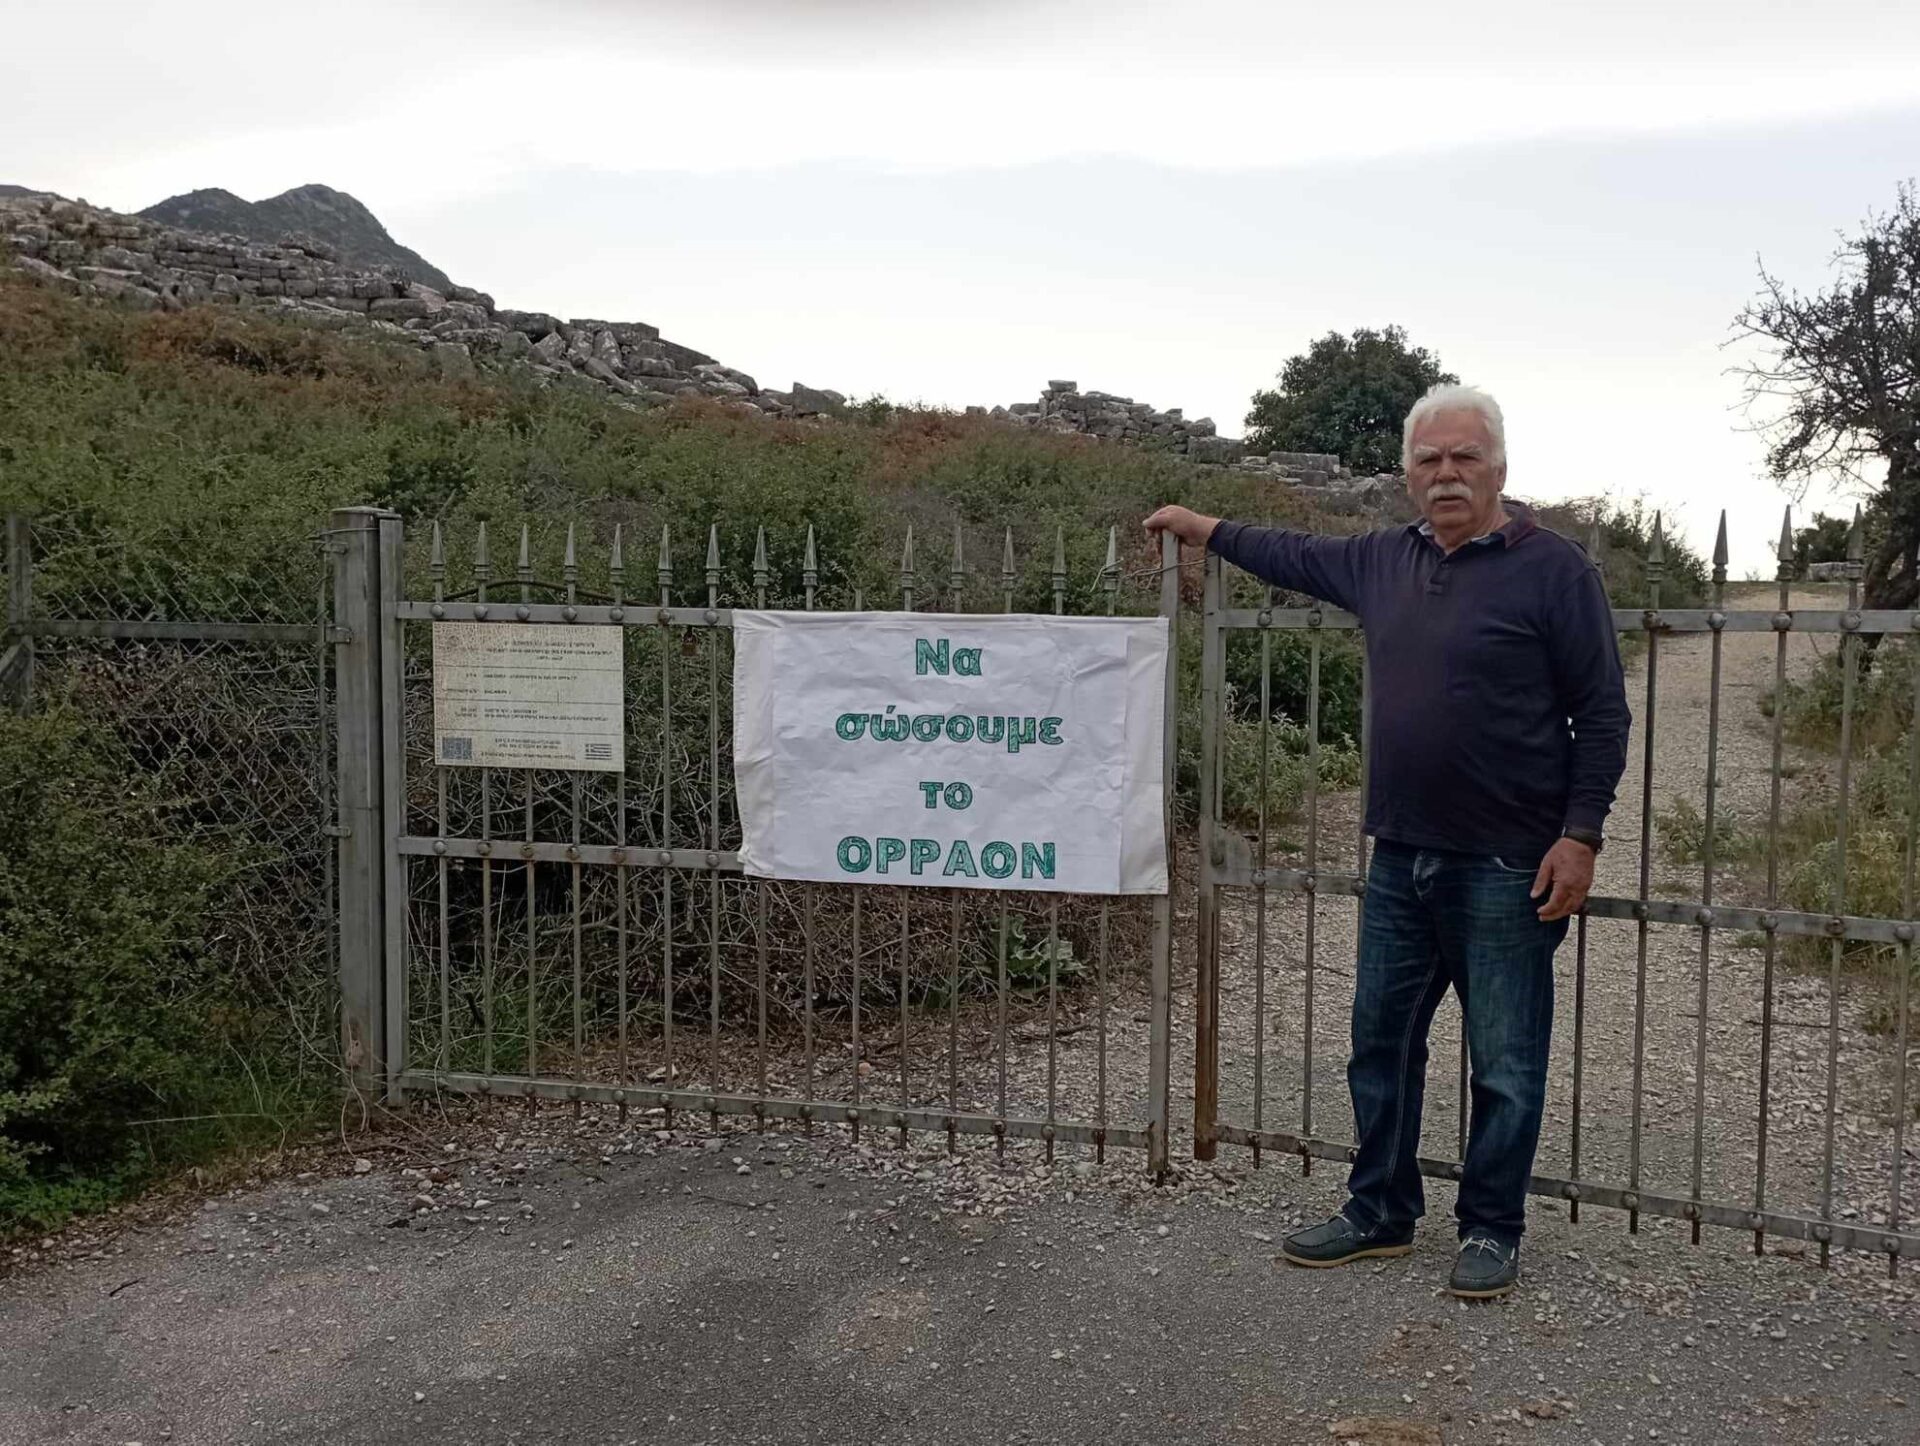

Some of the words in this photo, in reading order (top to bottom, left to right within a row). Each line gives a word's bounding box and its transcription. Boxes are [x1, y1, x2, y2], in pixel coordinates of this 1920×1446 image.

[915, 638, 982, 676] Να
[835, 705, 1064, 753] σώσουμε
[919, 781, 973, 810] το
[837, 836, 1057, 880] ΟΡΡΑΟΝ
